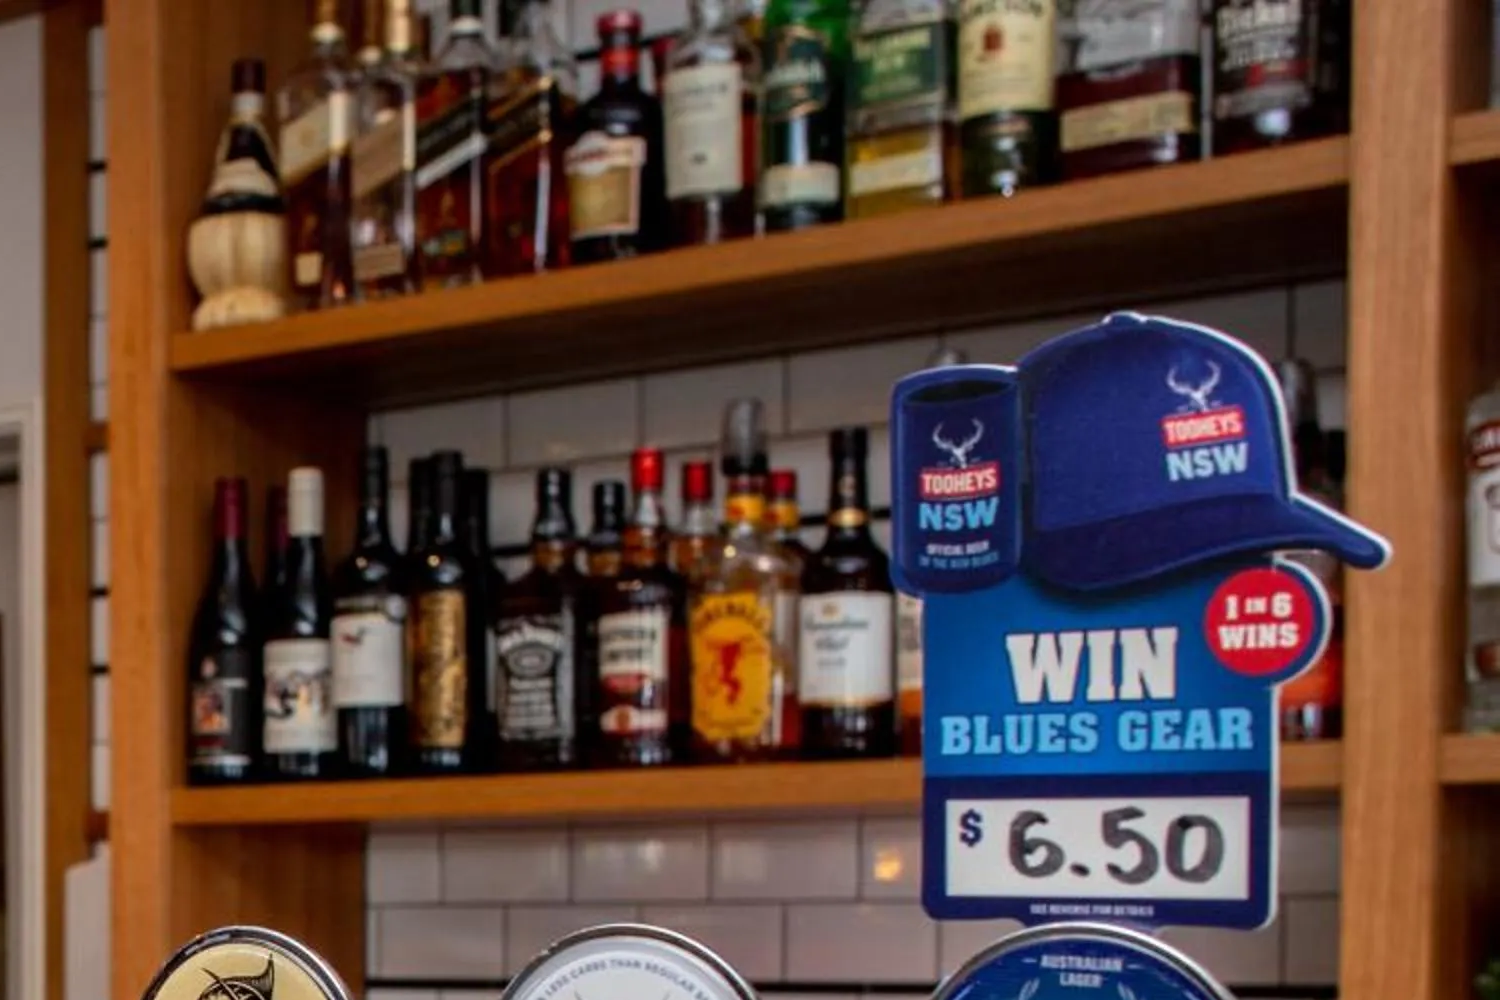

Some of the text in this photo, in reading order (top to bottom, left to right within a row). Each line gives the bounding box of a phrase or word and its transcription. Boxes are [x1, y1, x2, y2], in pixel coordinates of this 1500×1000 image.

[1164, 410, 1242, 443] TOOHEYS
[1166, 440, 1248, 482] NSW
[921, 467, 997, 494] TOOHEYS
[919, 496, 999, 531] NSW
[1226, 594, 1238, 620] 1
[1272, 592, 1293, 617] 6
[1218, 622, 1299, 650] WINS
[1005, 626, 1178, 704] WIN
[941, 707, 1253, 755] BLUES GEAR
[959, 806, 1224, 885] $ 6.50
[609, 959, 641, 970] THAN
[1040, 954, 1124, 972] AUSTRALIAN
[1060, 973, 1103, 988] LAGER
